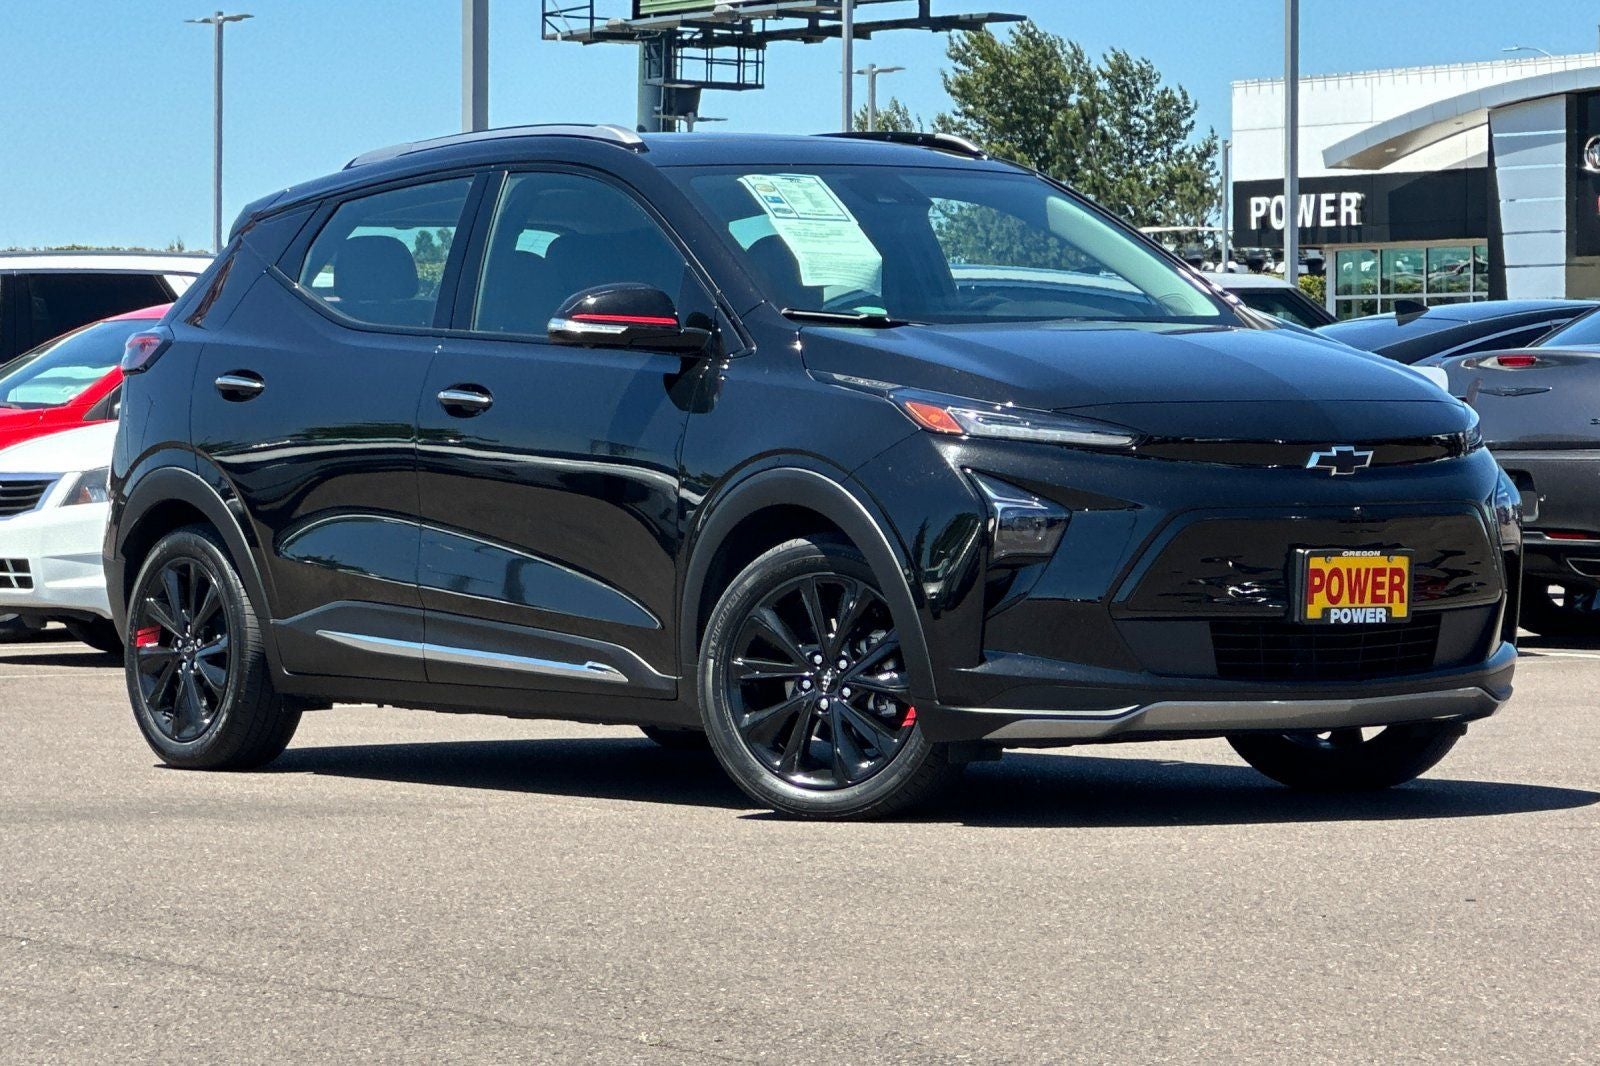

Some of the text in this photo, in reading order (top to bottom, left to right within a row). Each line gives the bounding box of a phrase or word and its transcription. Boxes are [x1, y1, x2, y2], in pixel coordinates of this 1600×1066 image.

[1250, 192, 1362, 230] POWER
[1307, 567, 1406, 605] POWER
[1330, 608, 1386, 623] POWER
